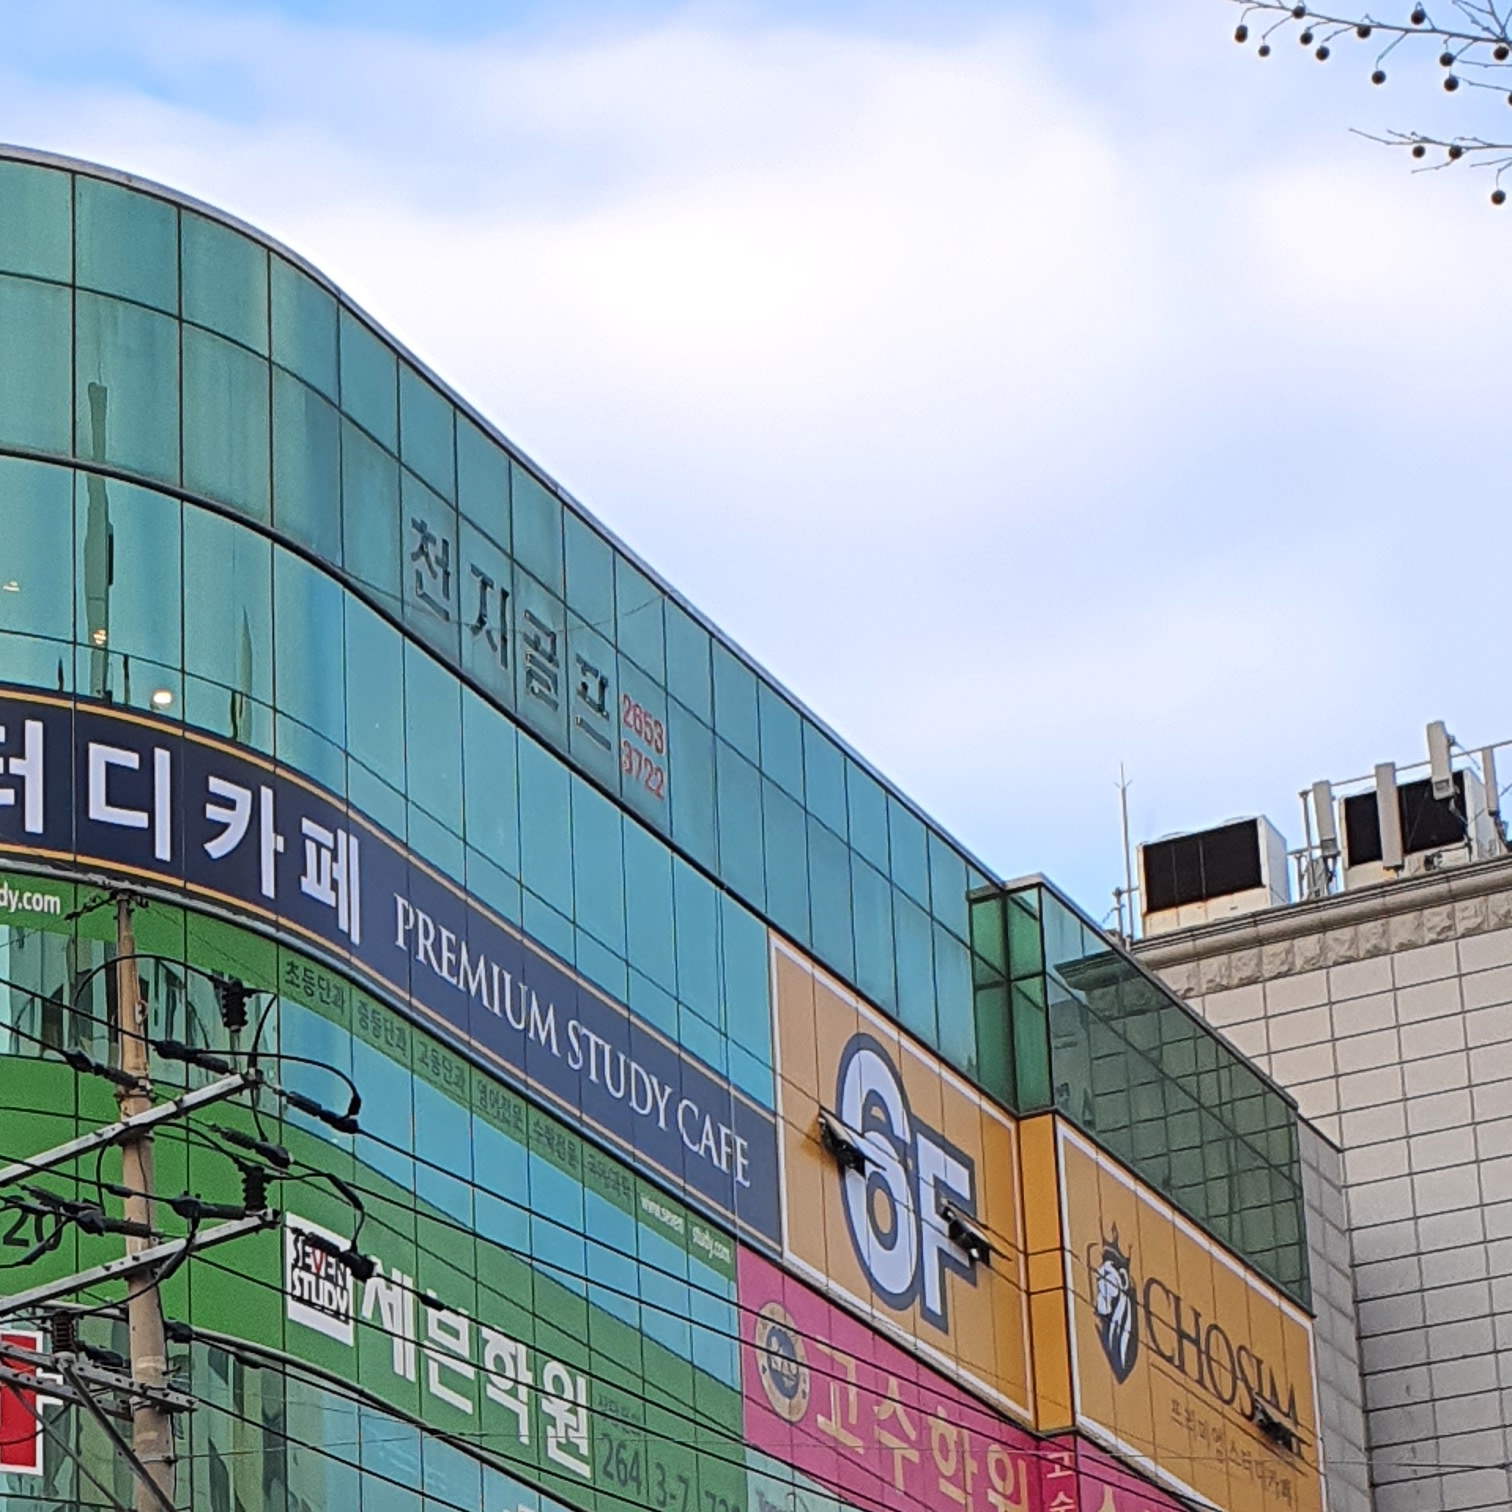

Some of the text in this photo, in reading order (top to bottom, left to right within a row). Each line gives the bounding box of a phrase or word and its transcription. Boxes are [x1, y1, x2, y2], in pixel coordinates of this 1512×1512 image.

[622, 693, 664, 755] 2653
[622, 741, 664, 800] 3722
[393, 894, 750, 1189] PREMIUM STUDY CAFE
[835, 1031, 977, 1335] 6F
[362, 1255, 591, 1478] 세븐학원
